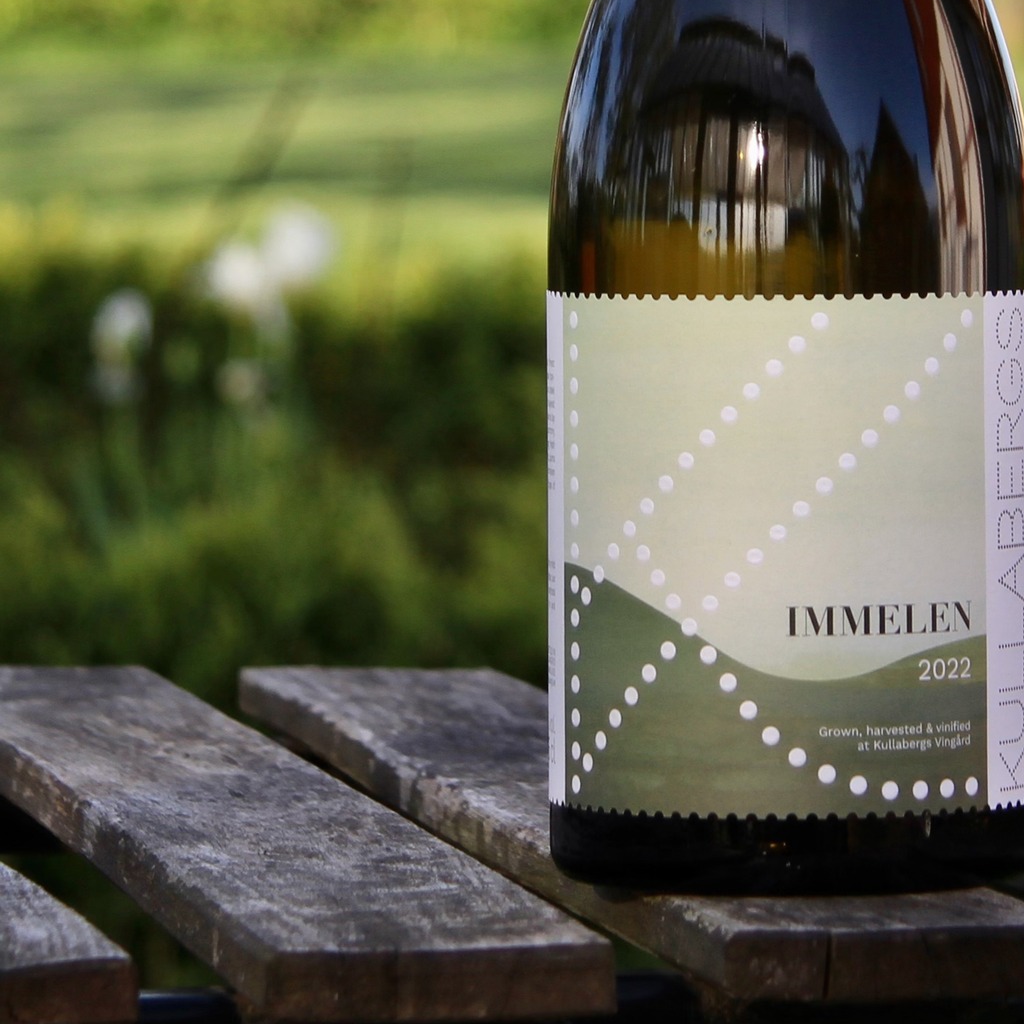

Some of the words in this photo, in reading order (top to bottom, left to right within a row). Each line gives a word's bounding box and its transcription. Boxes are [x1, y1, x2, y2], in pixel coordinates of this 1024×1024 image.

[786, 600, 972, 637] IMMELEN
[918, 657, 971, 681] 2022
[818, 726, 863, 738] Grown,
[866, 723, 923, 736] harvested
[926, 722, 933, 734] &
[935, 720, 971, 732] vinified
[857, 740, 870, 752] at
[873, 736, 932, 752] Kullabergs
[934, 733, 971, 749] Vingård
